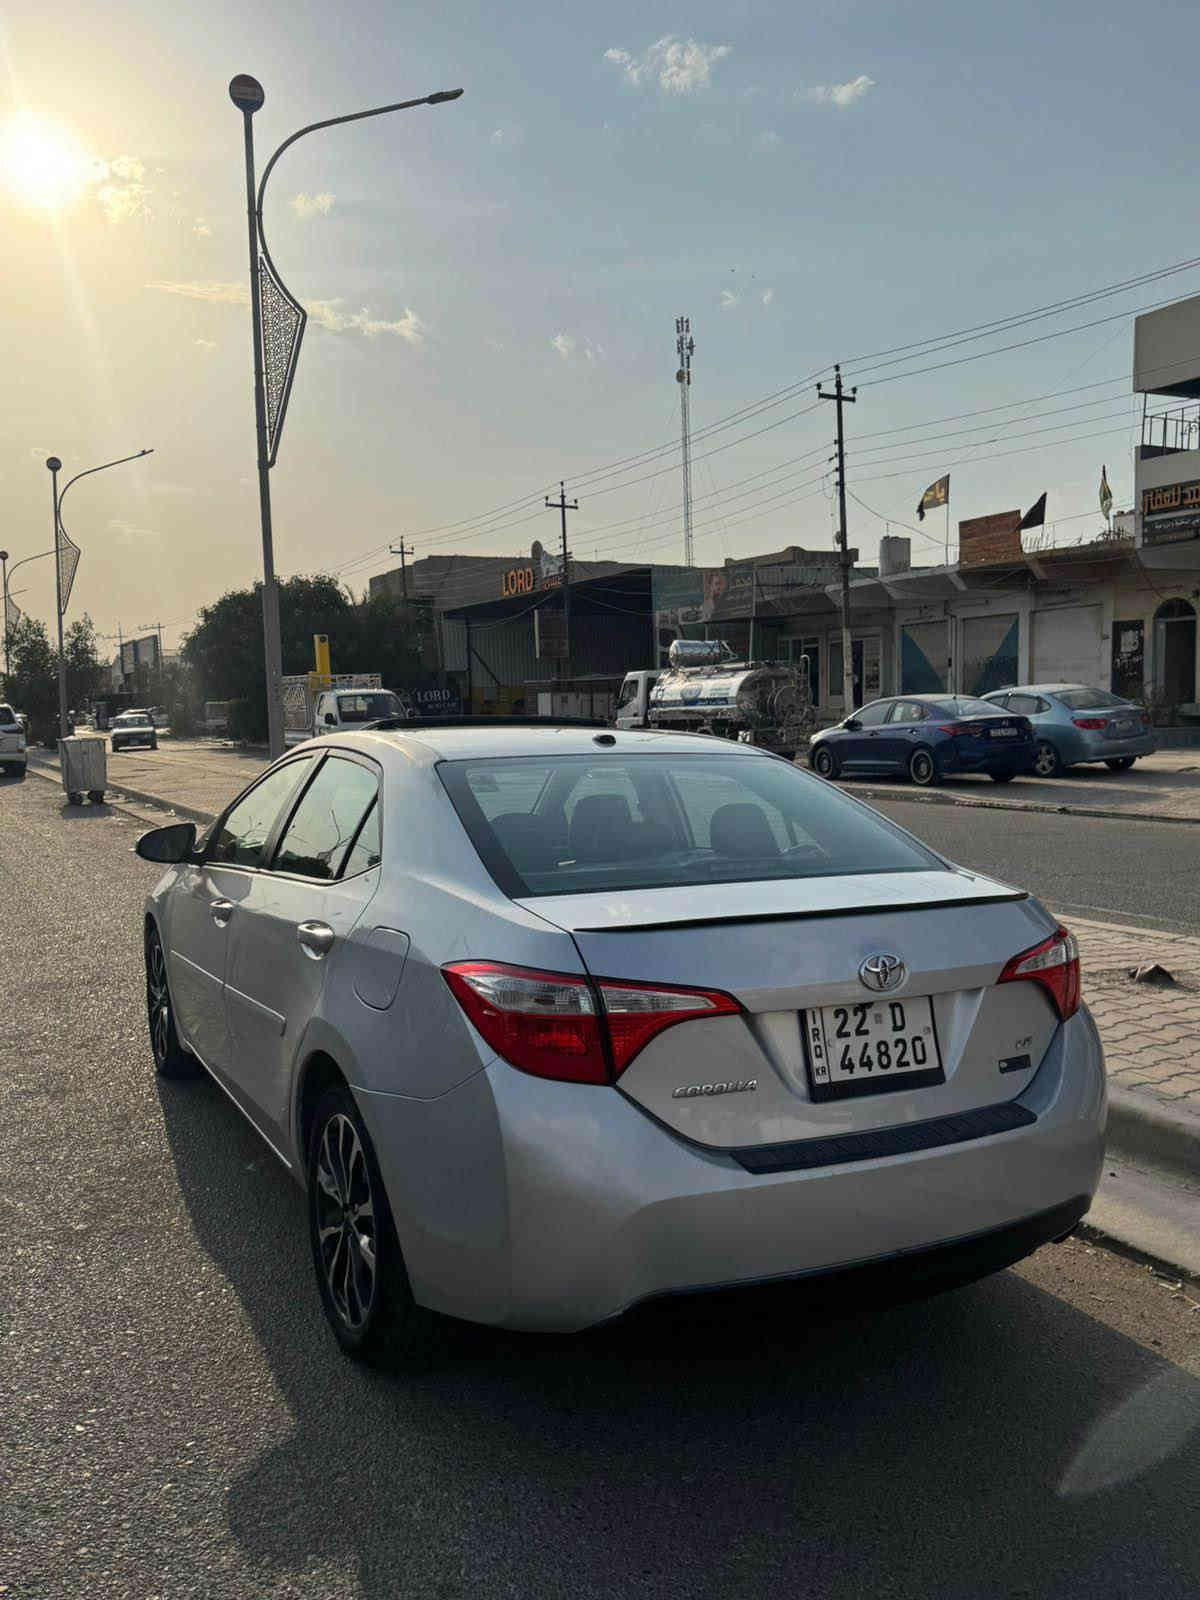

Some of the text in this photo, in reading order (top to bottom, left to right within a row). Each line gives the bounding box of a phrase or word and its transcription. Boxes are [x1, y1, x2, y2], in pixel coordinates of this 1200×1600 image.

[501, 568, 534, 597] LORD
[833, 1001, 906, 1038] 22 D
[840, 1035, 927, 1074] 44820
[672, 1080, 758, 1098] COROLLA
